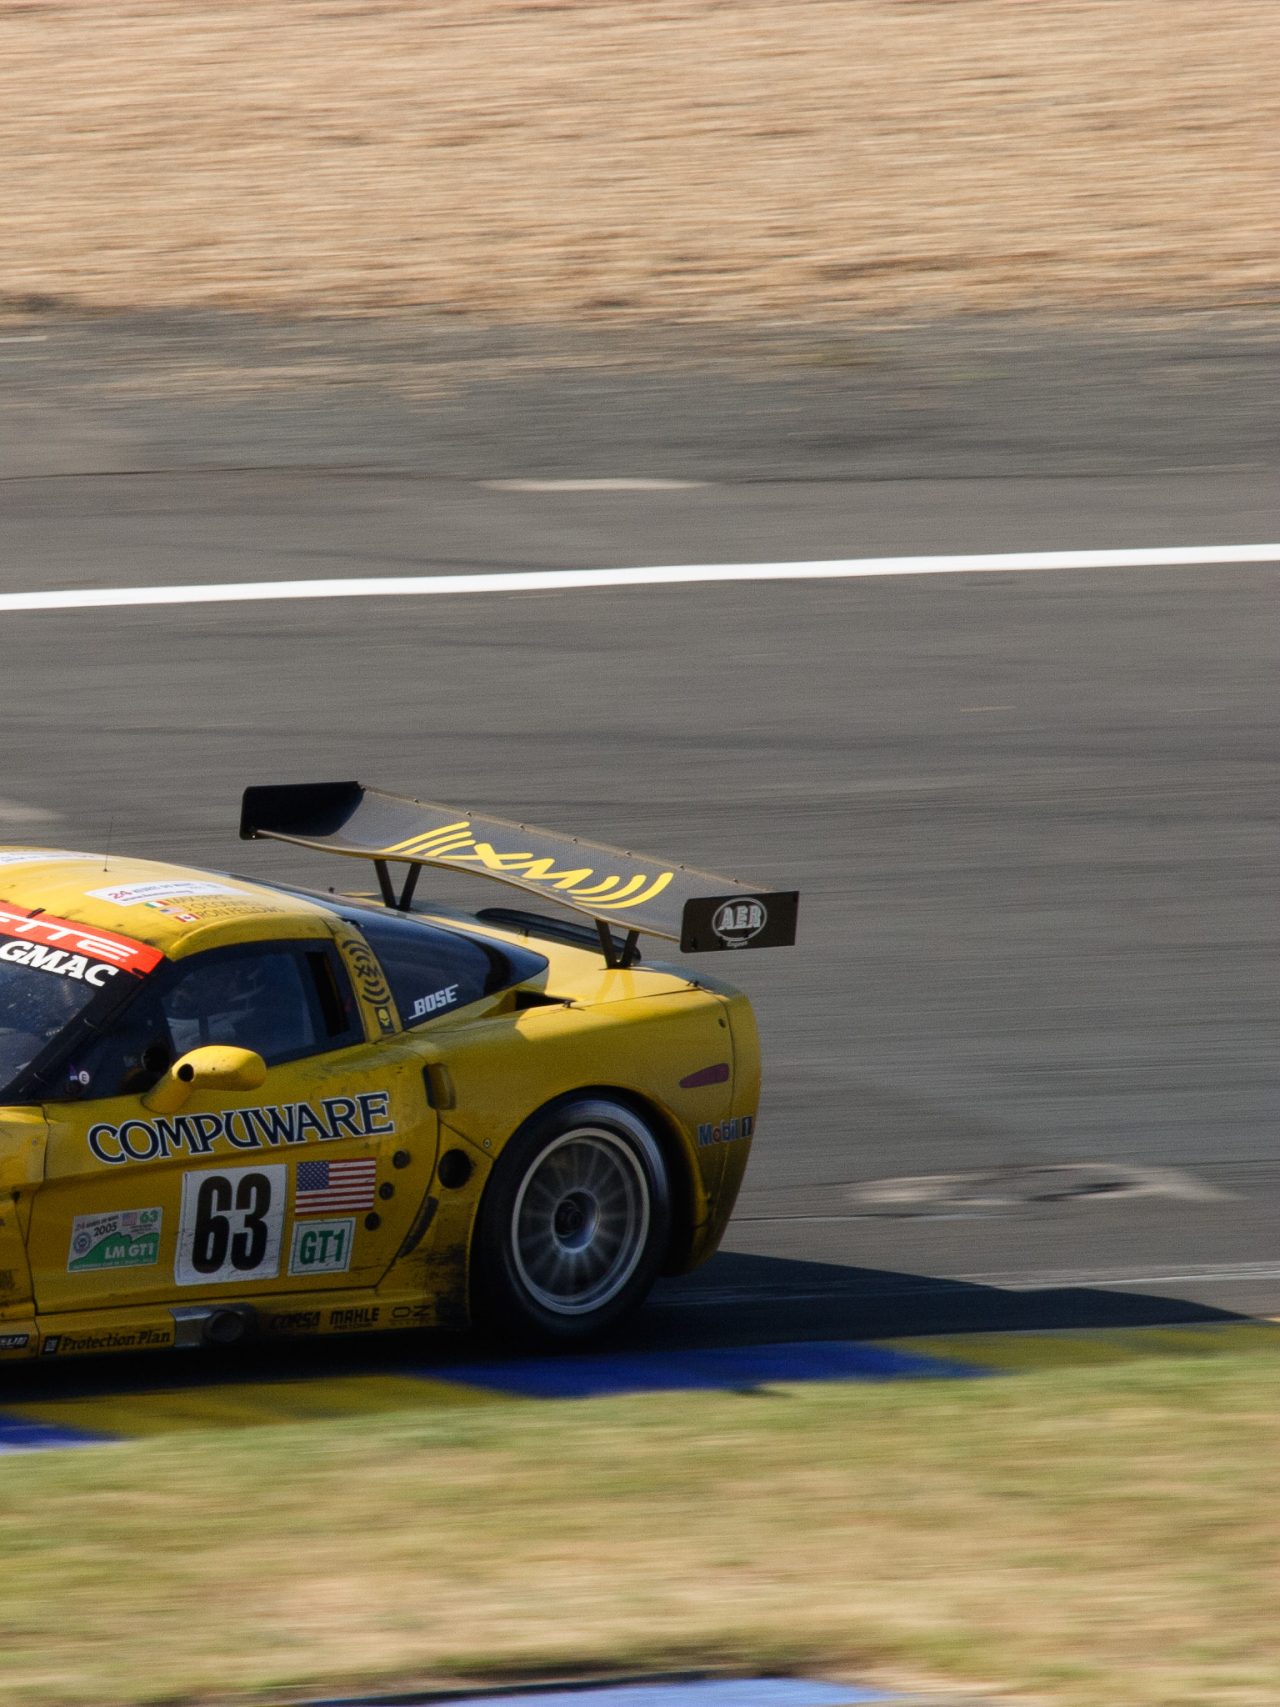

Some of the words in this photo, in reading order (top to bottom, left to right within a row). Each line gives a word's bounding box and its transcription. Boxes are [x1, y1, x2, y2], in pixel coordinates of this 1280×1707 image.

[717, 904, 762, 931] AER
[408, 983, 459, 1020] BOSE
[88, 1092, 395, 1163] COMPUWARE
[698, 1118, 738, 1147] Mobil
[741, 1116, 753, 1138] 1
[93, 1222, 118, 1238] 2005
[192, 1172, 273, 1274] 63
[104, 1245, 125, 1260] LM
[128, 1242, 155, 1258] GT1
[300, 1228, 346, 1265] GT1
[329, 1307, 381, 1326] MAHLE
[61, 1332, 136, 1351] Protection
[139, 1329, 170, 1345] Plan
